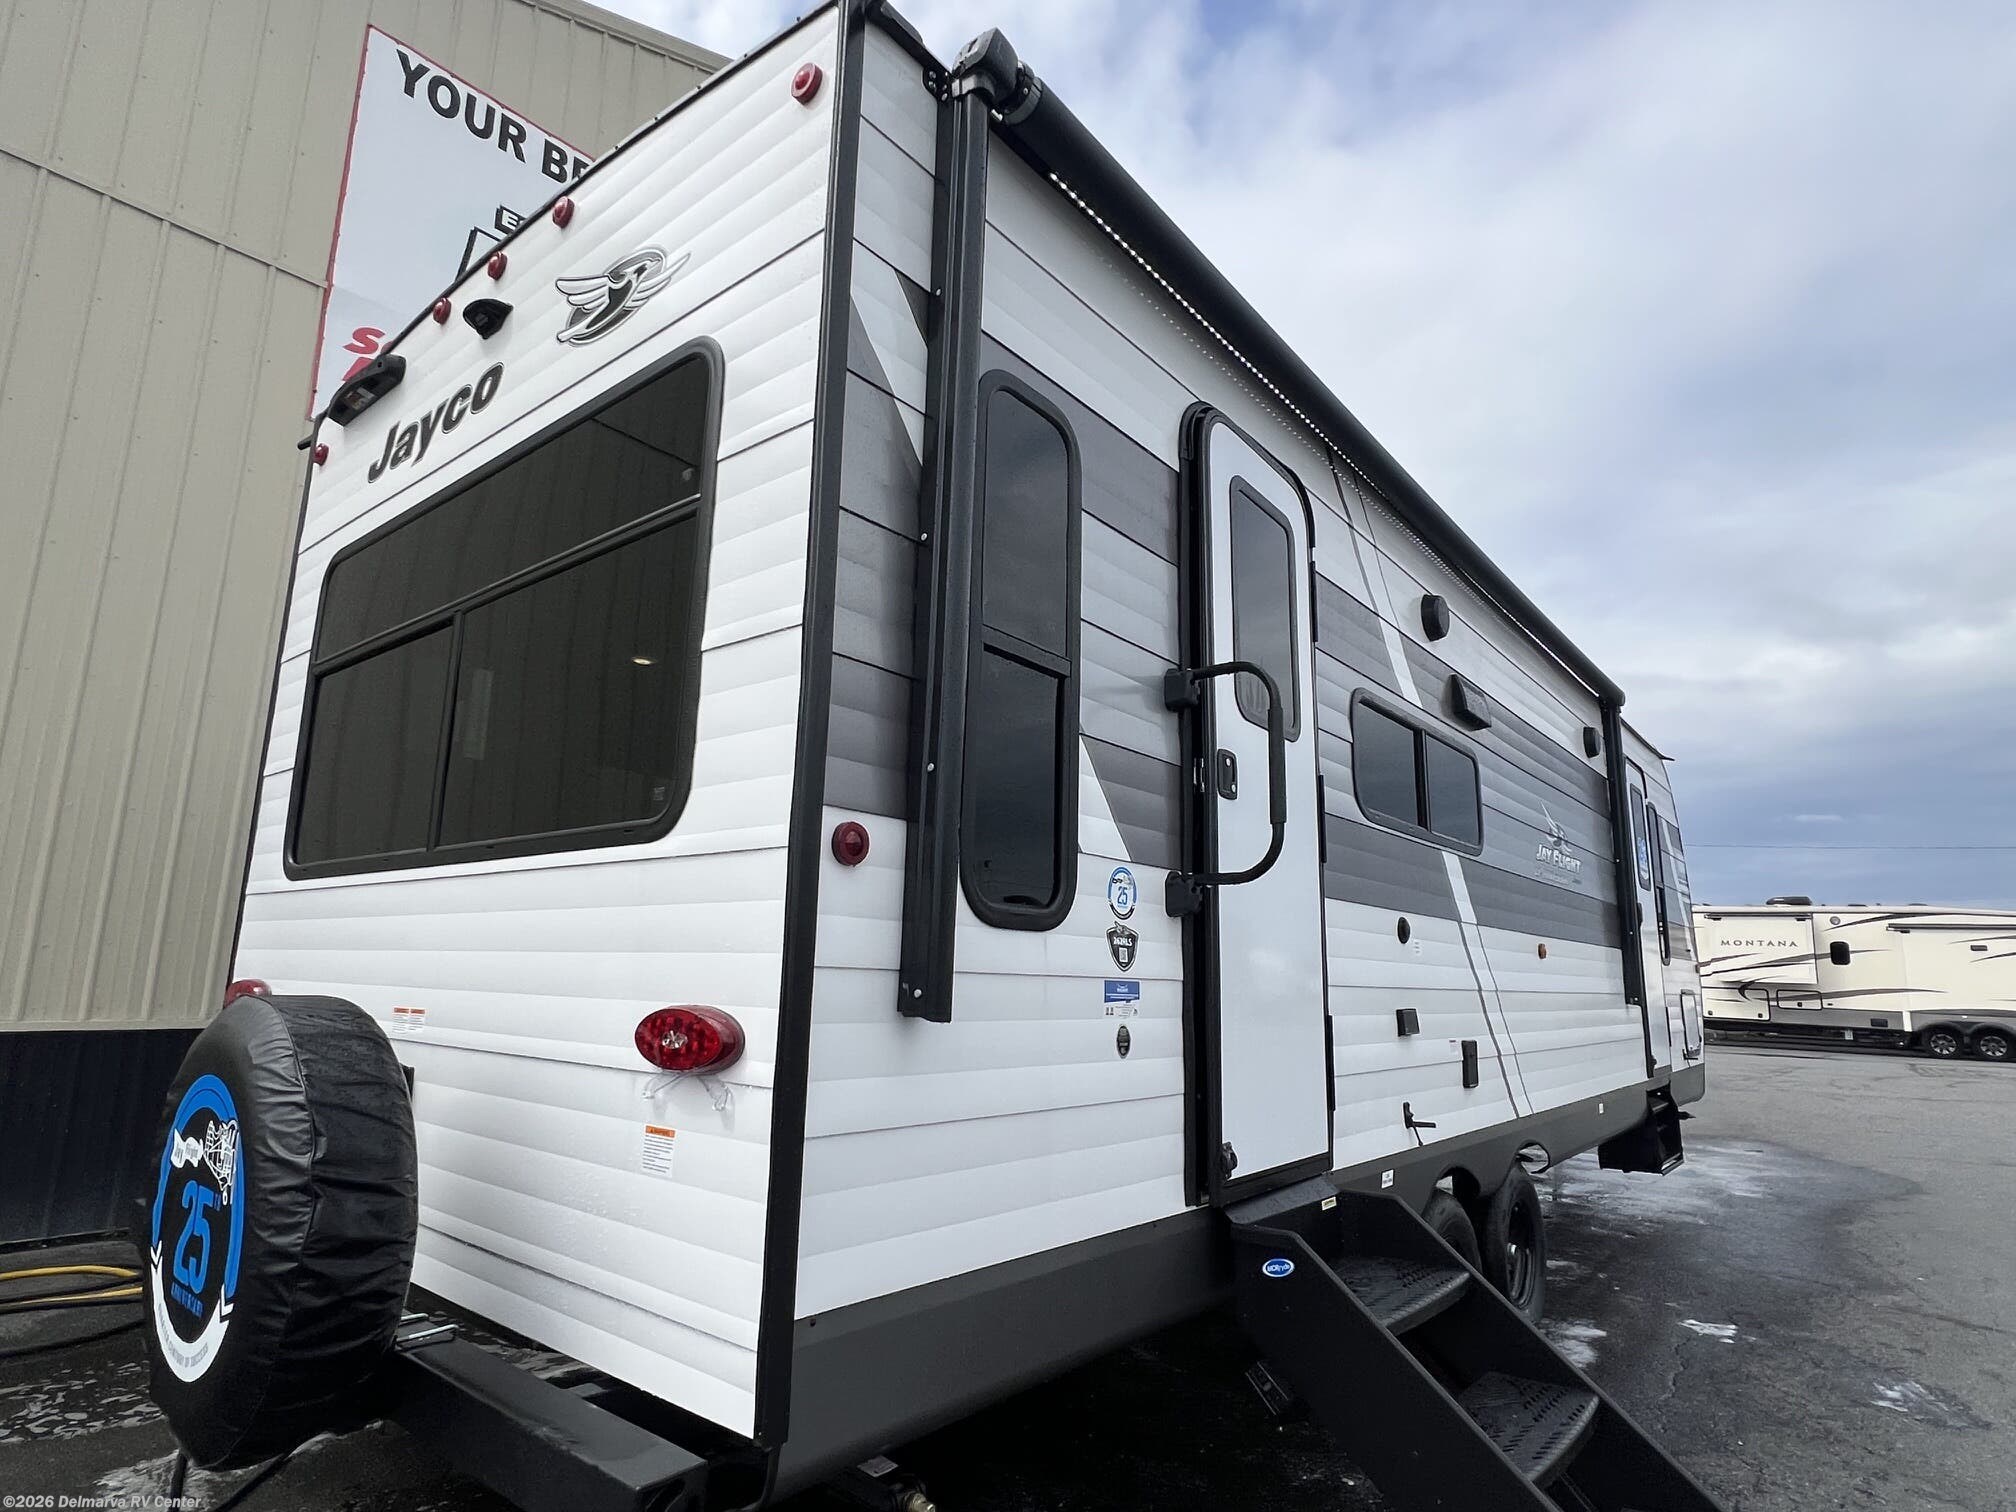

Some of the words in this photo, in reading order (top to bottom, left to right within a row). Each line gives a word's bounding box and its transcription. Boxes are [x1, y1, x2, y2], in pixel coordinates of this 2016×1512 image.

[396, 48, 527, 164] YOUR
[368, 361, 505, 484] Jayco
[1720, 939, 1799, 948] MONTANA
[173, 1179, 211, 1295] 25
